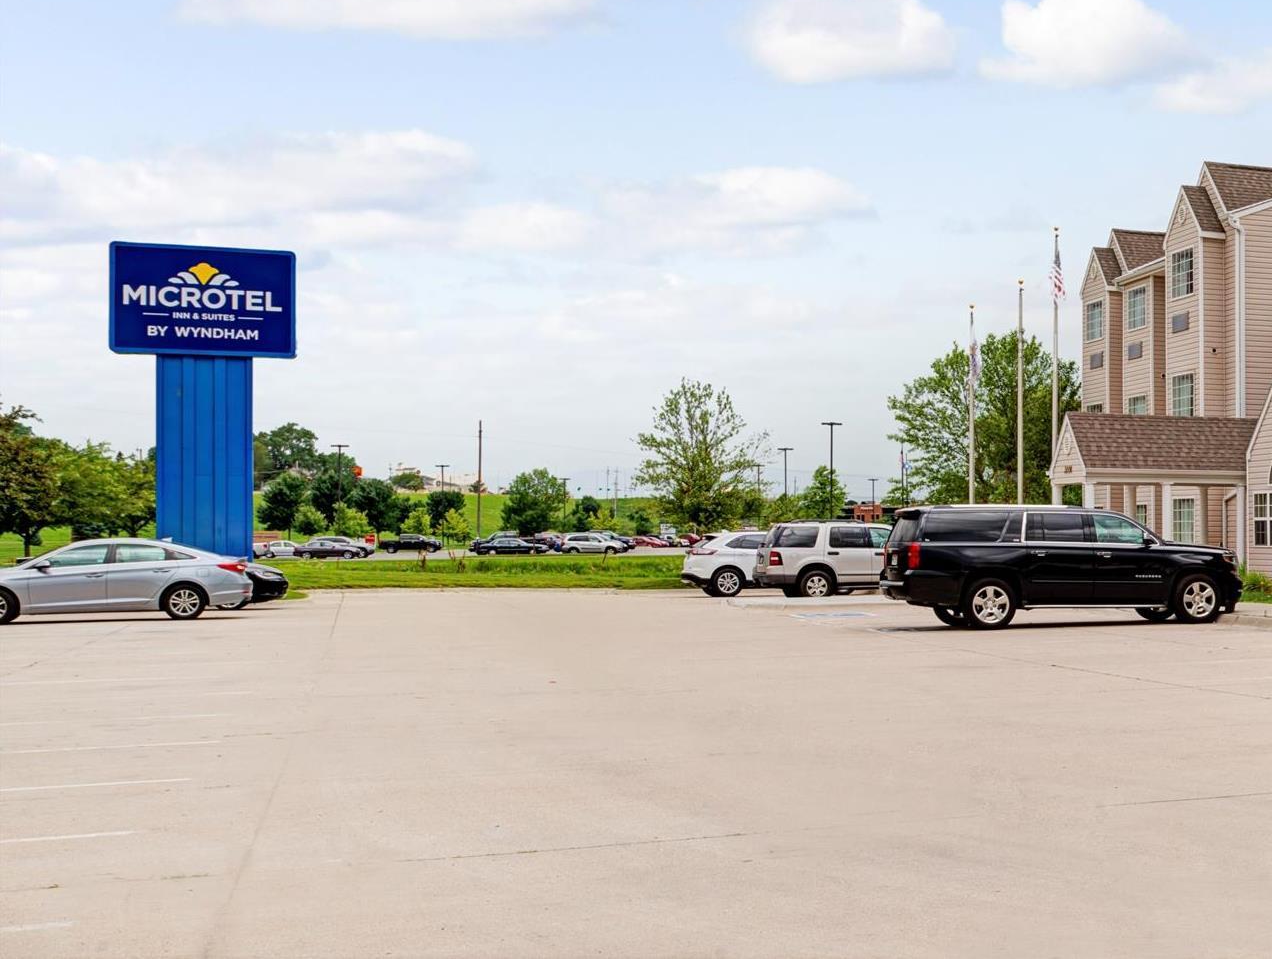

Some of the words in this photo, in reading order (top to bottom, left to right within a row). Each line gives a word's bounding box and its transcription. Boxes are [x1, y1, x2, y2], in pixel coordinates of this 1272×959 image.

[122, 284, 283, 312] MICROTEL
[172, 311, 191, 319] INN
[201, 313, 236, 322] SUITES
[147, 325, 168, 337] BY
[174, 326, 259, 340] WYNDHAM
